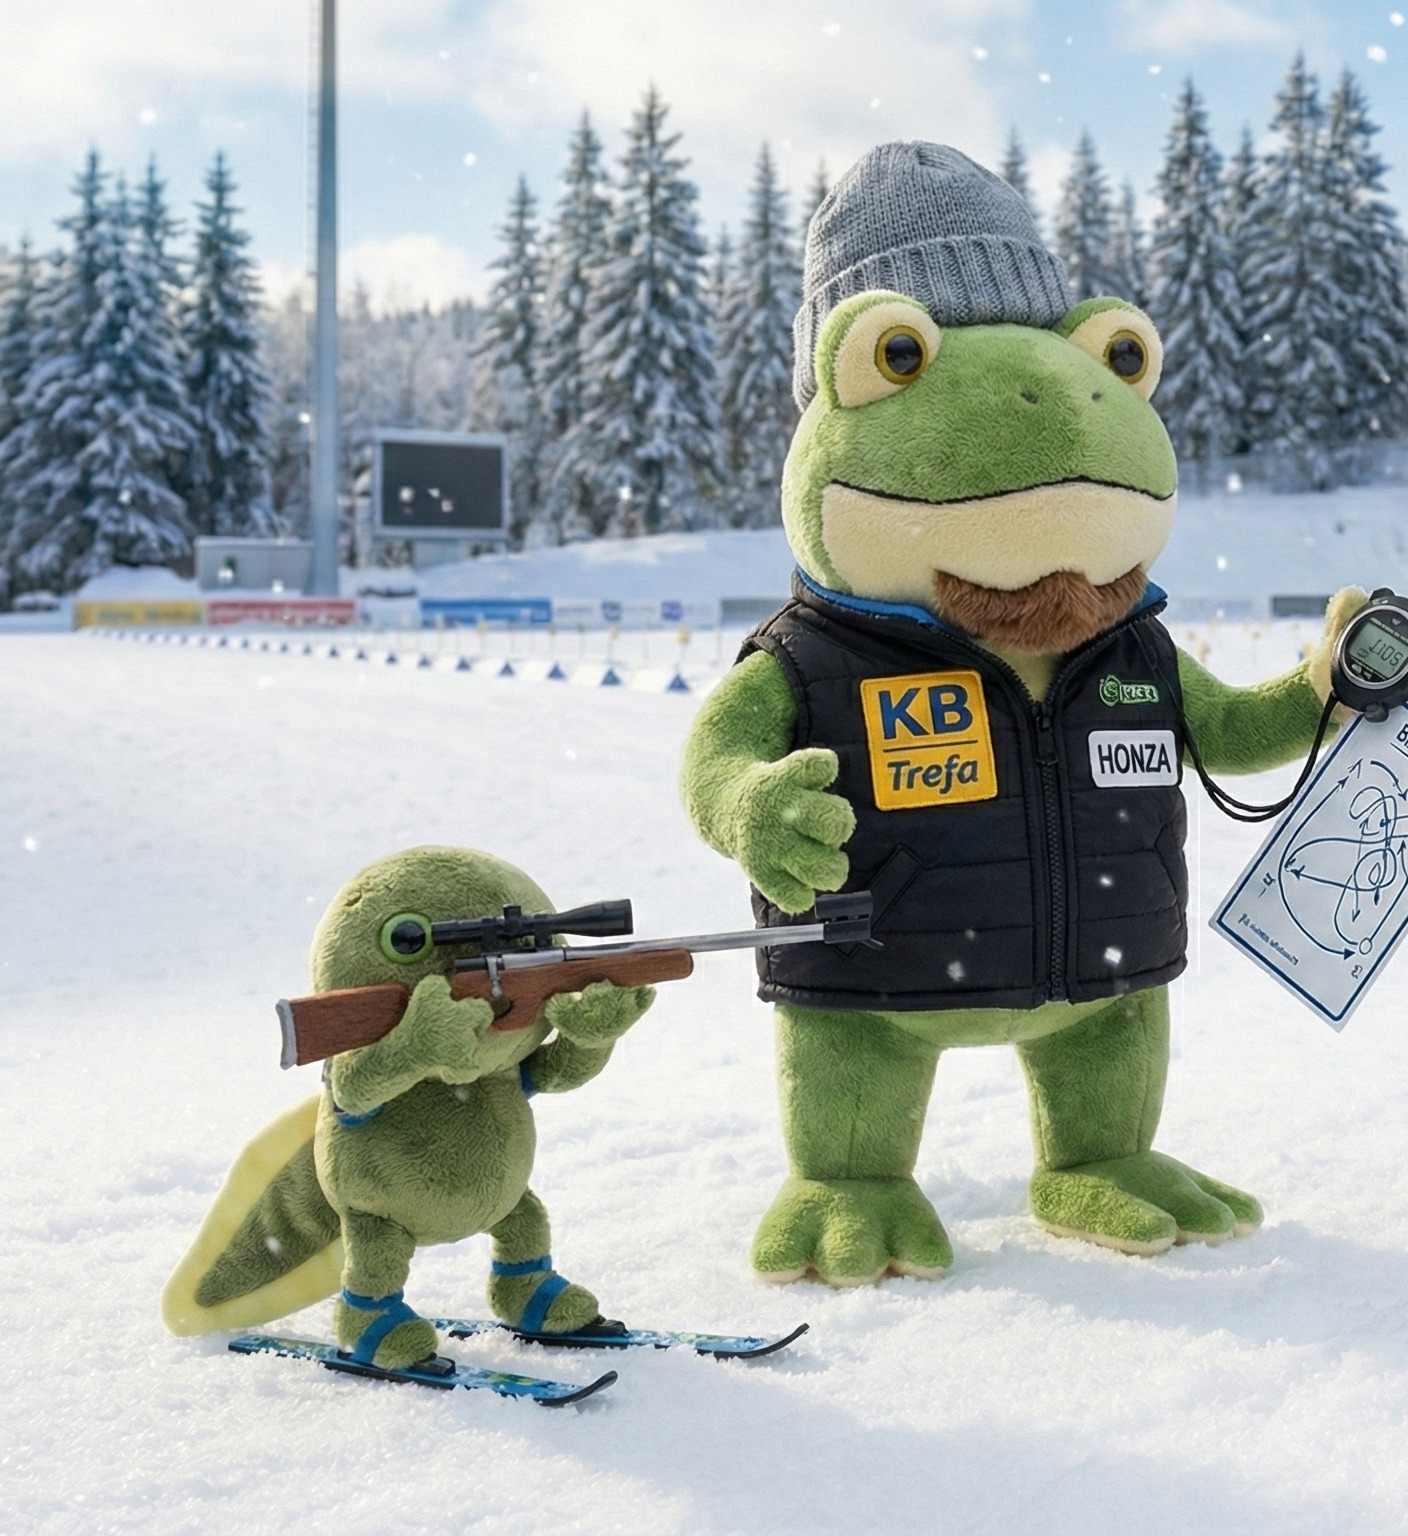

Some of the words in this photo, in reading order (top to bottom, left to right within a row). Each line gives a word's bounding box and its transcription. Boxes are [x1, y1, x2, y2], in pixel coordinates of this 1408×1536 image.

[879, 684, 973, 740] KB
[887, 754, 979, 795] Trefa
[1098, 743, 1171, 774] HONZA
